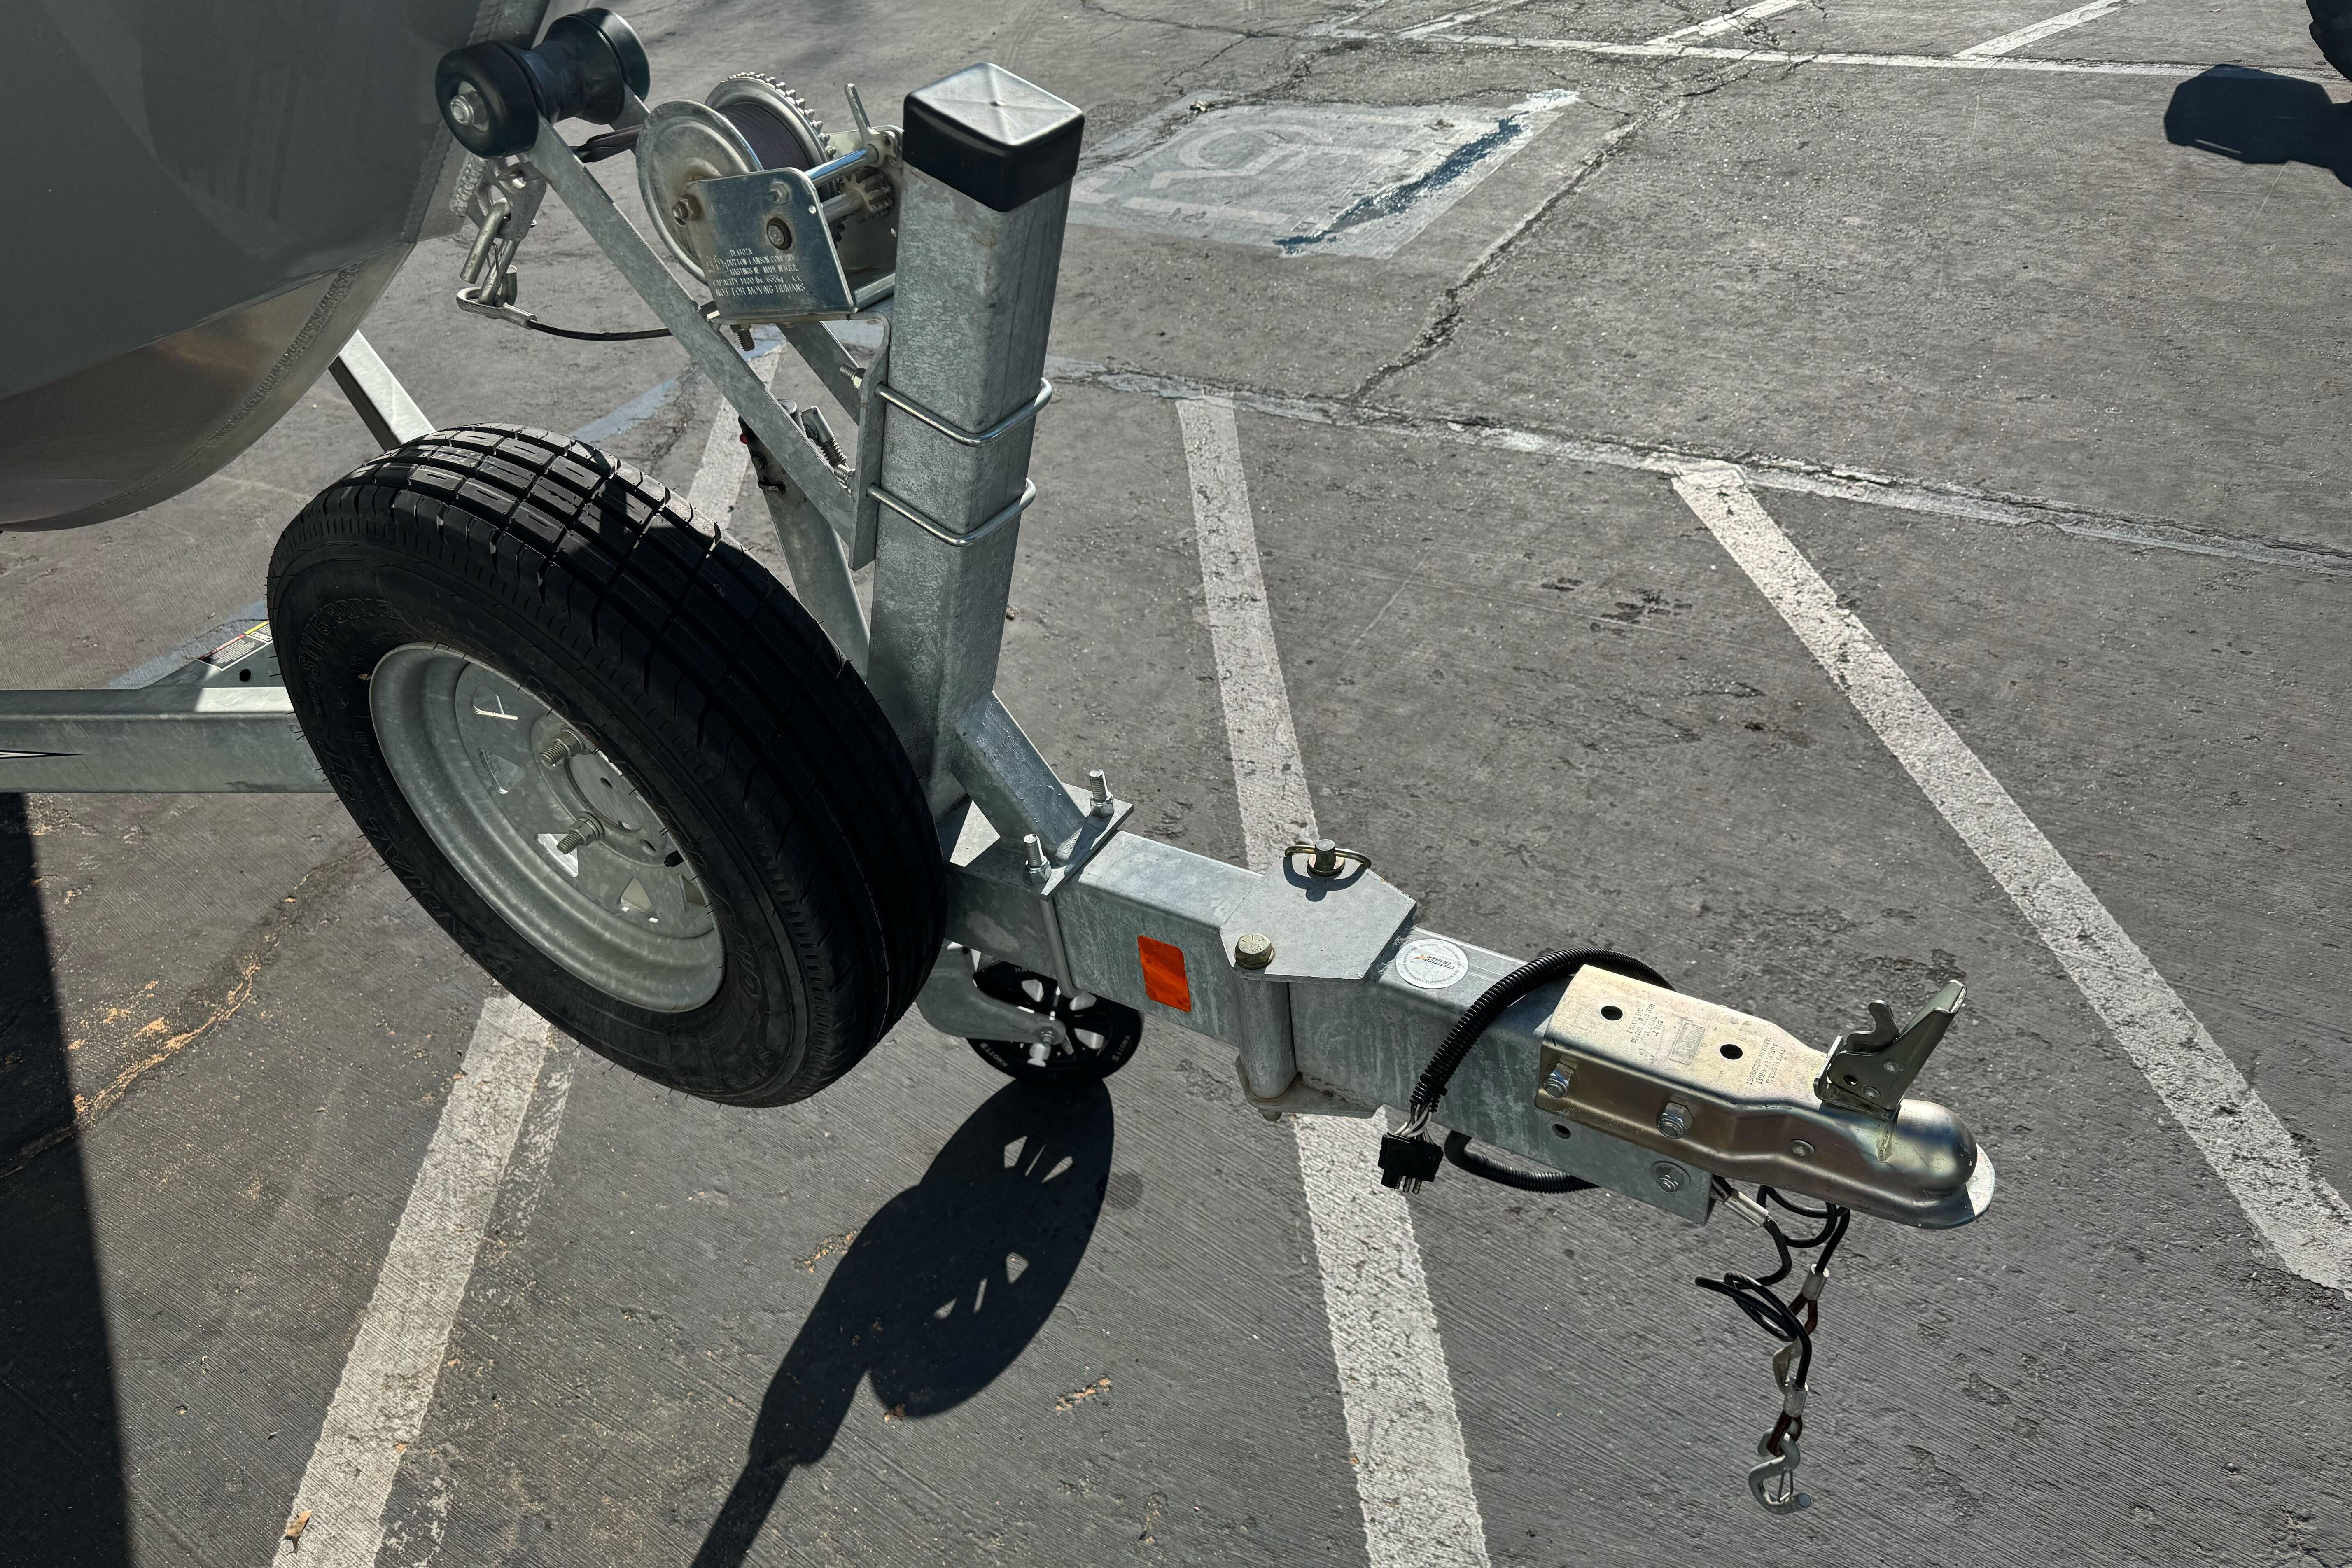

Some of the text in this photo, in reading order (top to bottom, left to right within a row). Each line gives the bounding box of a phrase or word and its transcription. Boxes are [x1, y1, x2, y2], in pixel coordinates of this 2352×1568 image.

[715, 282, 805, 296] NOT FOR MOVING HUMANS
[1116, 1035, 1130, 1055] KNOTT
[985, 1047, 1008, 1067] KNOTT
